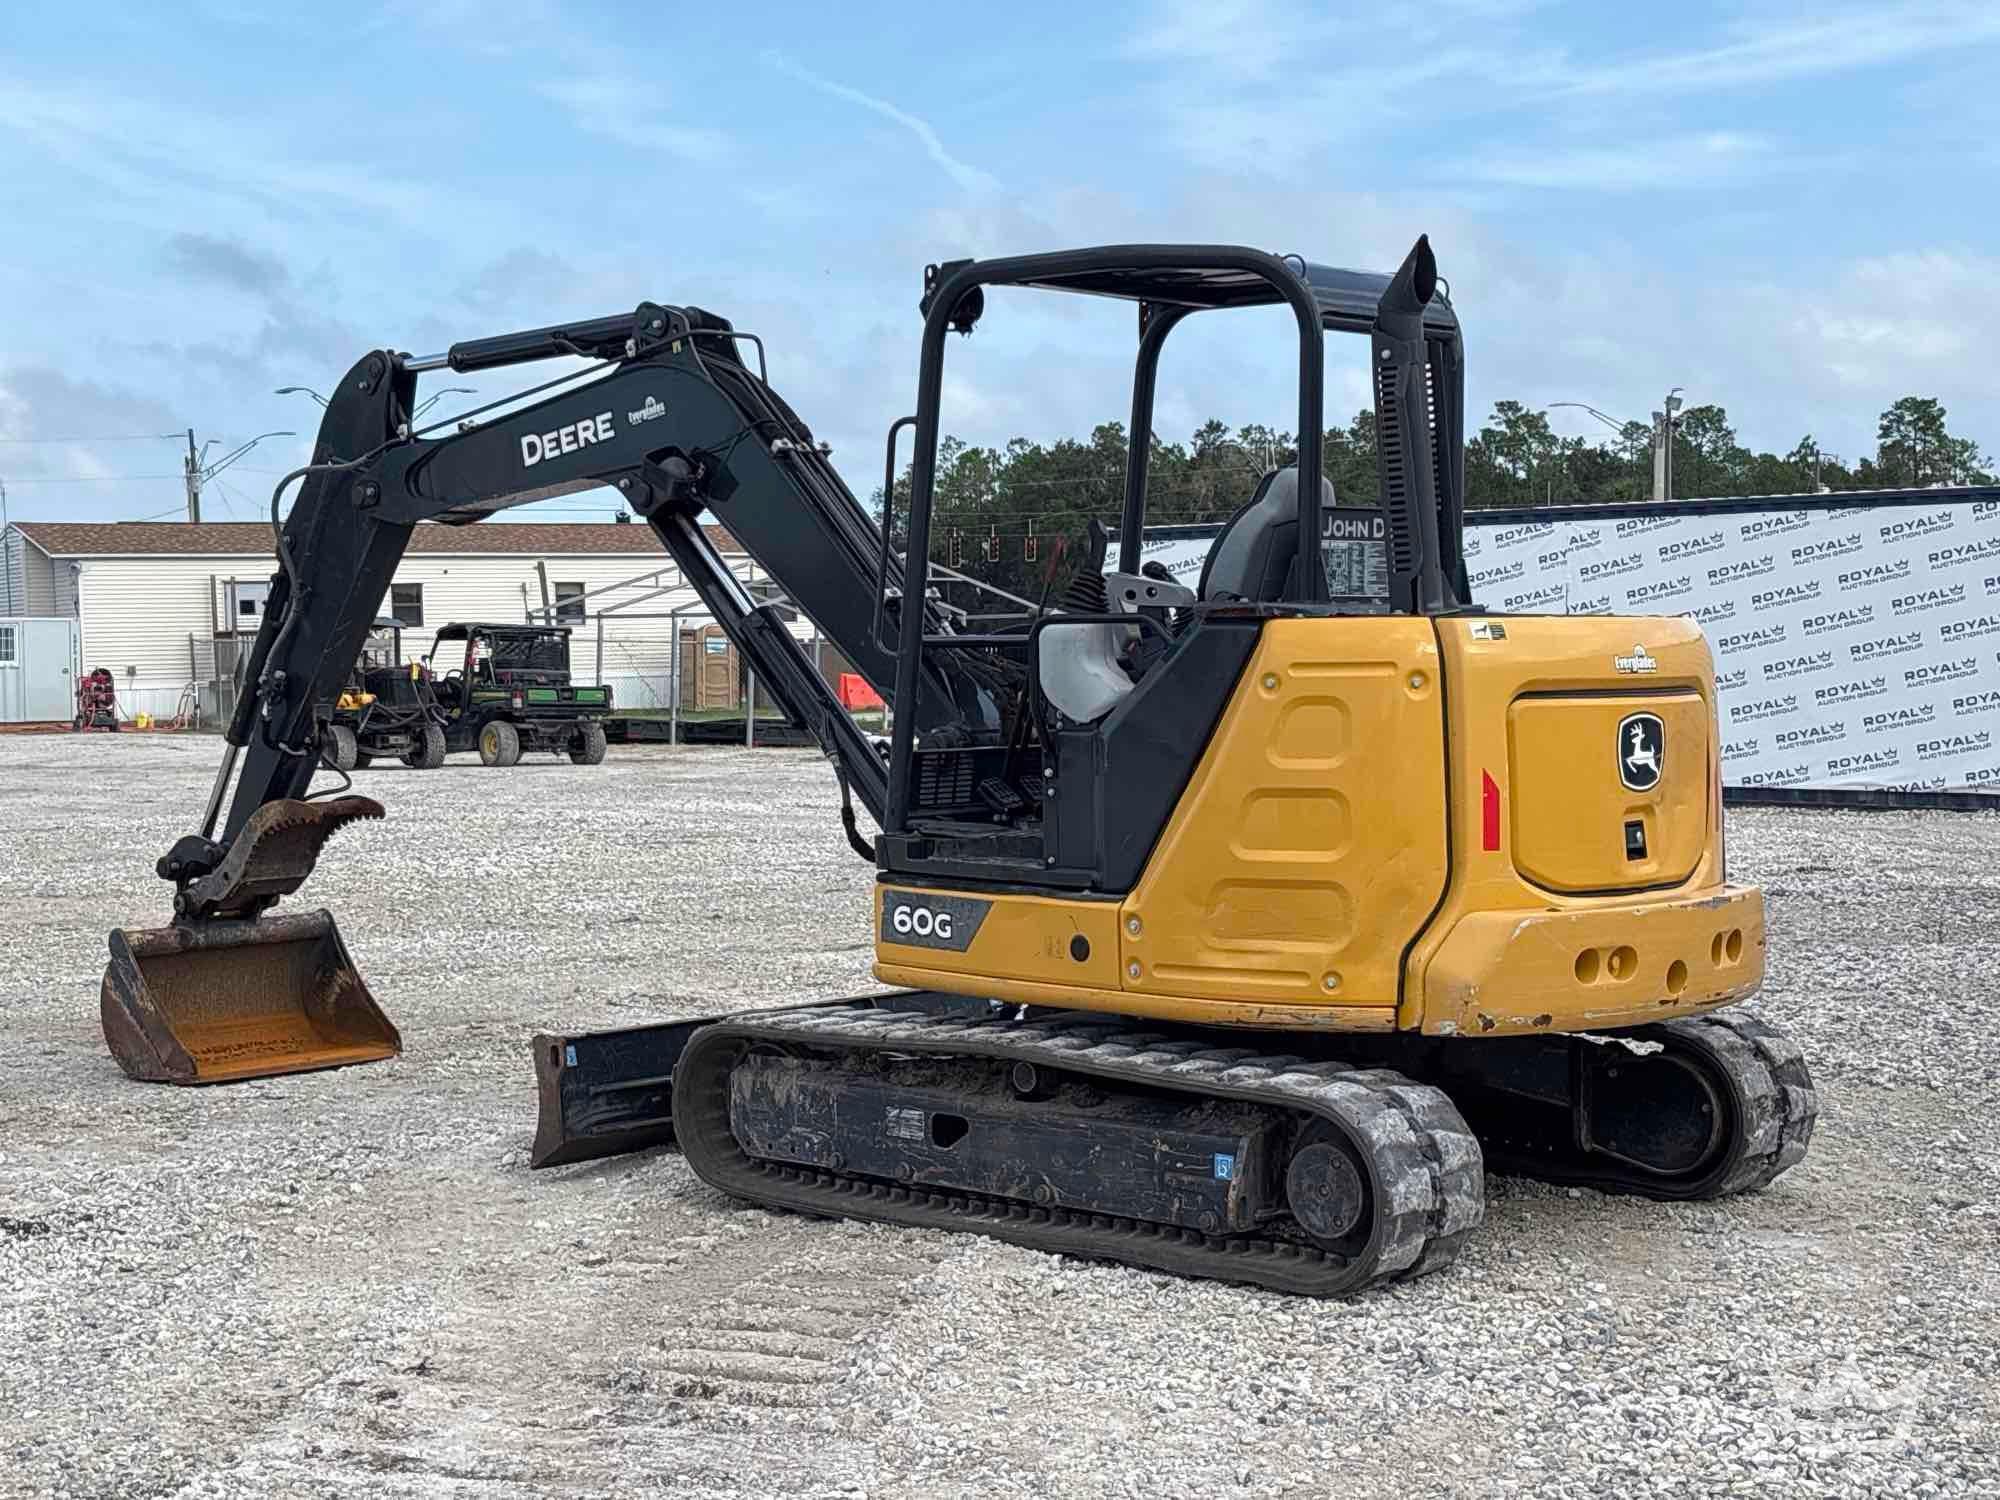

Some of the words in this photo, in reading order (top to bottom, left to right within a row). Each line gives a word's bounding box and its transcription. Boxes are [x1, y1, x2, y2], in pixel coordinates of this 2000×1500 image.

[520, 411, 615, 468] DEERE
[1322, 515, 1369, 538] JOHN
[1495, 523, 1541, 542] ROYAL
[1741, 516, 1794, 536] ROYAL
[1743, 529, 1779, 542] AUCTION
[1781, 521, 1810, 533] GROUP
[1880, 516, 1938, 537] ROYAL
[1882, 531, 1921, 544] AUCTION
[1923, 522, 1954, 535] GROUP
[1659, 536, 1711, 557] ROYAL
[1661, 551, 1696, 563] AUCTION
[1697, 542, 1725, 555] GROUP
[1792, 539, 1847, 559] ROYAL
[1793, 553, 1831, 566] AUCTION
[1832, 544, 1863, 556] GROUP
[1928, 542, 1987, 563] ROYAL
[1167, 558, 1197, 573] OYAL
[1538, 549, 1567, 565] ROY
[1580, 557, 1626, 576] ROYAL
[1930, 557, 1971, 570] AUCTION
[1972, 549, 2000, 561] GROU
[1708, 560, 1760, 580] ROYAL
[1710, 573, 1745, 586] AUCTION
[1747, 566, 1775, 578] GROUP
[1839, 564, 1894, 584] ROYAL
[1627, 580, 1677, 600] ROYAL
[1840, 578, 1878, 591] AUCTION
[1880, 570, 1911, 582] GROUP
[1505, 588, 1547, 608] ROYAL
[1629, 593, 1663, 606] AUCTION
[1664, 586, 1692, 598] GROUP
[1752, 585, 1807, 605] ROYAL
[1753, 599, 1791, 612] AUCTION
[1792, 592, 1822, 604] GROUP
[1892, 589, 1950, 609] ROYAL
[1570, 600, 1598, 613] YAL
[1893, 603, 1933, 616] AUCTION
[1934, 595, 1966, 607] GROUP
[1803, 609, 1858, 630] ROYAL
[1805, 623, 1842, 636] AUCTION
[1844, 616, 1875, 627] GROUP
[1940, 616, 1999, 635] ROYAL
[1719, 629, 1771, 648] ROYAL
[1721, 643, 1756, 655] AUCTION
[1758, 635, 1787, 647] GROUP
[1850, 636, 1907, 656] ROYAL
[1852, 650, 1891, 662] AUCTION
[1893, 642, 1924, 654] GROUP
[1614, 655, 1657, 671] Everglades
[1764, 655, 1817, 674] ROYAL
[1766, 668, 1802, 681] AUCTION
[1804, 661, 1834, 673] GROUP
[1905, 661, 1961, 681] ROYAL
[1906, 675, 1946, 688] AUCTION
[1947, 668, 1978, 680] GROUP
[1815, 681, 1872, 700] ROYAL
[1817, 694, 1856, 707] AUCTION
[1857, 688, 1888, 699] GROUP
[1953, 691, 2000, 709] ROYA
[1731, 699, 1783, 717] ROYAL
[1732, 712, 1769, 724] AUCTION
[1770, 706, 1799, 717] GROUP
[1863, 708, 1920, 727] ROYAL
[1865, 722, 1904, 733] AUCTION
[1905, 715, 1936, 727] GROUP
[1776, 725, 1830, 744] ROYAL
[1778, 738, 1815, 750] AUCTION
[1817, 733, 1846, 744] GROUP
[1917, 735, 1975, 754] ROYAL
[1828, 752, 1884, 770] ROYAL
[1918, 749, 1959, 761] AUCTION
[1960, 742, 1992, 754] GROUP
[1742, 768, 1795, 785] ROYAL
[1830, 766, 1868, 777] AUCTION
[1869, 759, 1900, 770] GROUP
[1965, 768, 2000, 782] ROY
[893, 905, 951, 939] 60G
